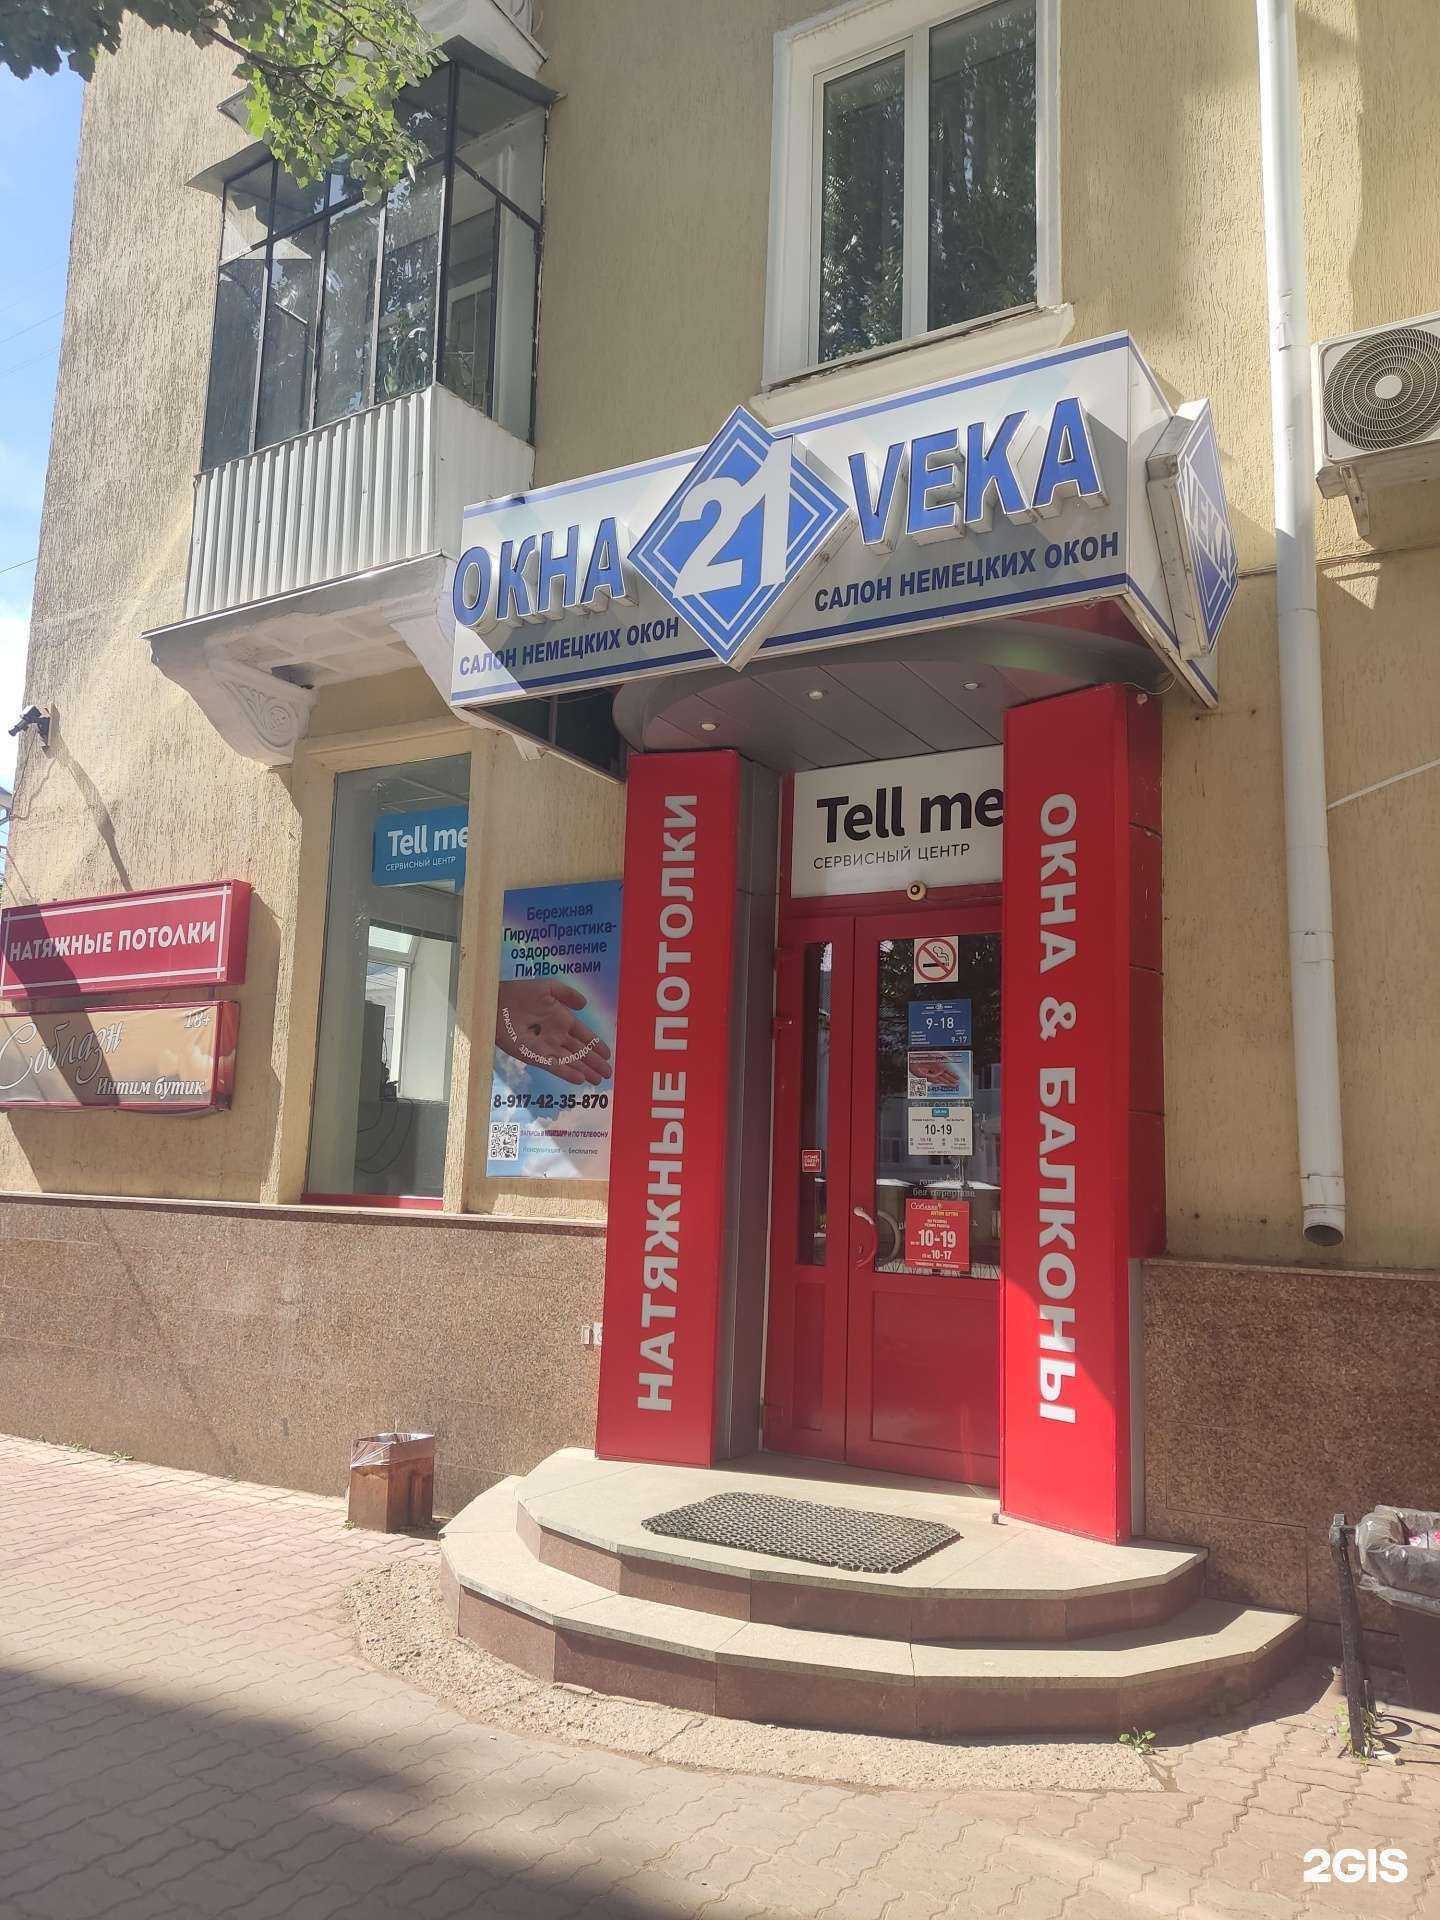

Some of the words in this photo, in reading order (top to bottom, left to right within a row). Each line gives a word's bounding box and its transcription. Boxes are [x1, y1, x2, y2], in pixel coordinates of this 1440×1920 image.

[452, 517, 627, 627] ОКНА
[673, 434, 794, 598] 21
[848, 397, 1103, 546] VEKA
[814, 576, 892, 613] САЛОН
[899, 548, 1036, 597] НЕМЕЦКИХ
[1044, 531, 1119, 570] ОКОН
[459, 649, 517, 676] САЛОН
[522, 628, 621, 667] НЕМЕЦКИХ
[626, 617, 679, 646] ОКОН
[816, 785, 905, 843] Tell
[919, 788, 1004, 834] me
[388, 824, 428, 857] Tell
[433, 827, 468, 852] me
[813, 845, 912, 870] СЕРВИСНЫЙ
[917, 843, 971, 861] ЦЕНТР
[385, 859, 431, 872] СЕРВИСНЫЙ
[432, 856, 456, 866] ЦЕНТР
[1039, 792, 1077, 975] ОКНА
[527, 904, 593, 922] Бережная
[654, 794, 698, 1051] ПОТОЛКИ
[9, 931, 112, 962] НАТЯЖНЫЕ
[117, 920, 217, 951] ПОТОЛКИ
[511, 941, 607, 960] оздоровление
[515, 961, 601, 978] ПиЯВочками
[184, 1009, 212, 1029] 18+
[926, 1016, 955, 1030] 9-18
[1039, 996, 1077, 1042] &
[502, 1007, 519, 1042] КРАСОТА
[519, 1044, 553, 1066] ЗДОРОВЬЕ
[558, 1036, 600, 1065] МОЛОДОСТЬ
[96, 1077, 152, 1095] Интим
[153, 1075, 206, 1100] бутик
[493, 1094, 609, 1109] 8-917-42-35-870
[925, 1124, 952, 1135] 10-19
[636, 1071, 687, 1412] НАТЯЖНЫЕ
[918, 1229, 957, 1248] 10-19
[1039, 1066, 1076, 1424] БАЛКОНЫ
